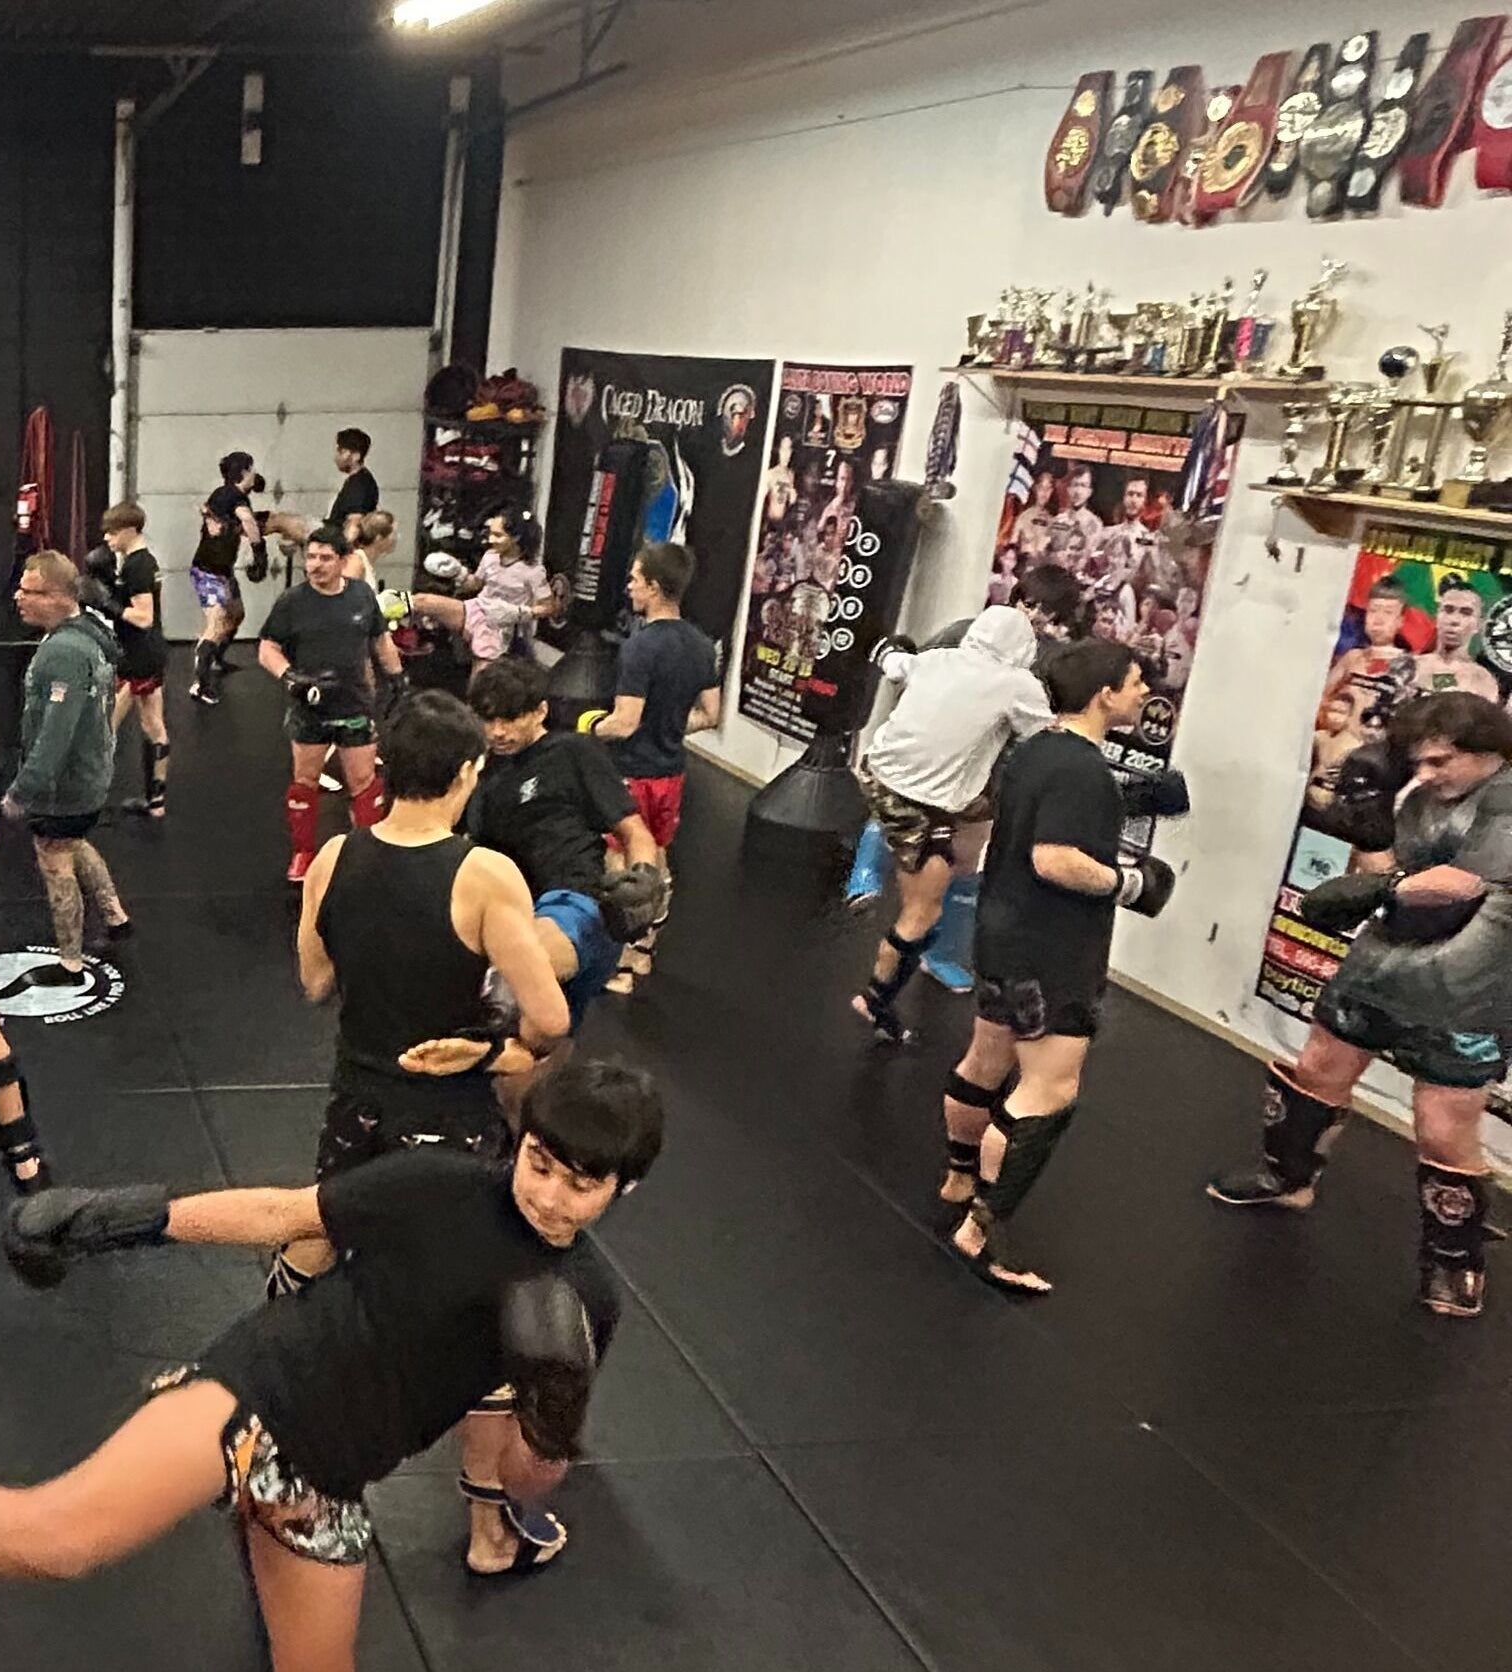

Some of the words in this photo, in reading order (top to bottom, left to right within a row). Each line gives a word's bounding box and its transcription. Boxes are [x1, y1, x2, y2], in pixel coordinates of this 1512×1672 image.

[602, 384, 643, 425] CAGED
[643, 389, 705, 431] DRAGON
[1124, 748, 1165, 772] 2022
[44, 1011, 84, 1025] ROLL
